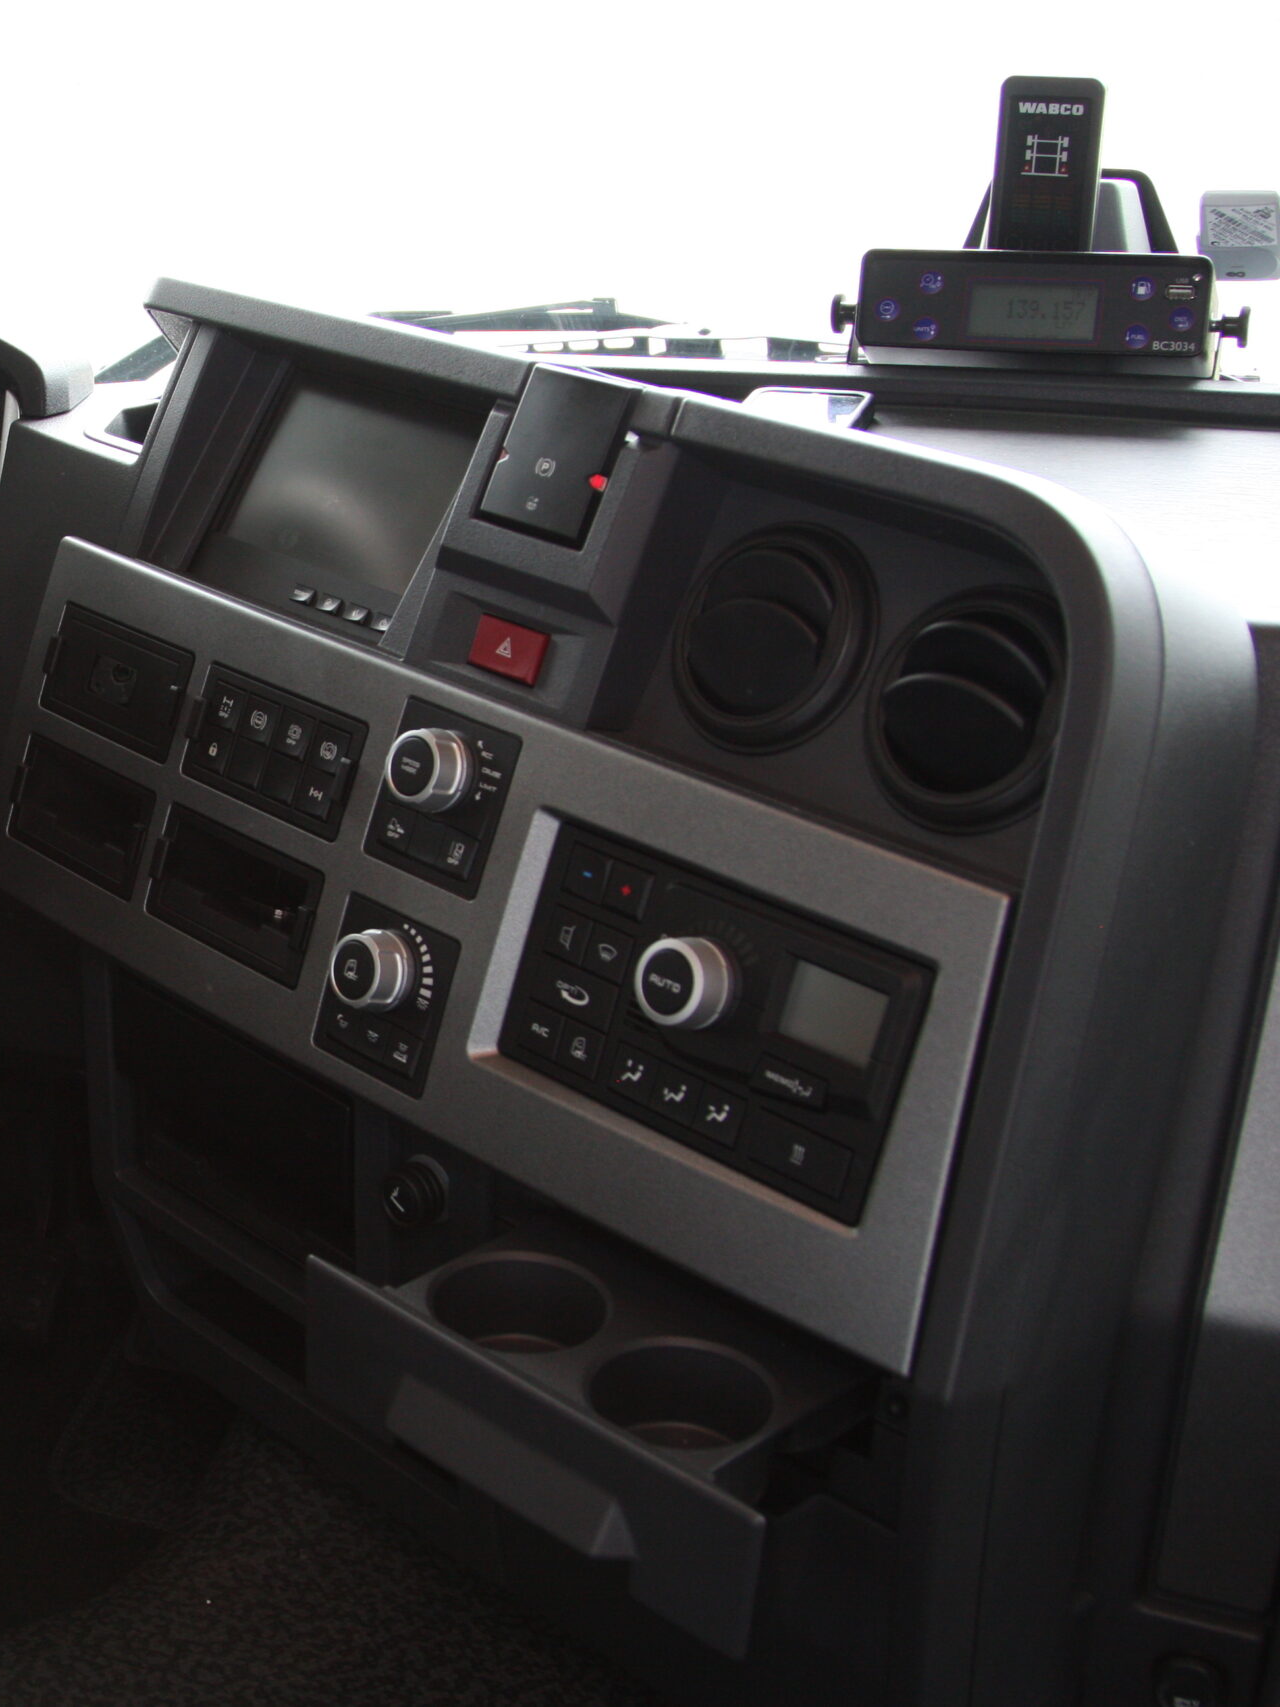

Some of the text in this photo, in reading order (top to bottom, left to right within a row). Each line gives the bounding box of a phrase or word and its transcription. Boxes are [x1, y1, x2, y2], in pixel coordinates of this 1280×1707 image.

[1018, 102, 1084, 116] WABCO
[1006, 299, 1086, 321] 139.157
[1152, 341, 1196, 351] BC3034
[648, 972, 682, 994] AUTO
[530, 1022, 551, 1038] A/C
